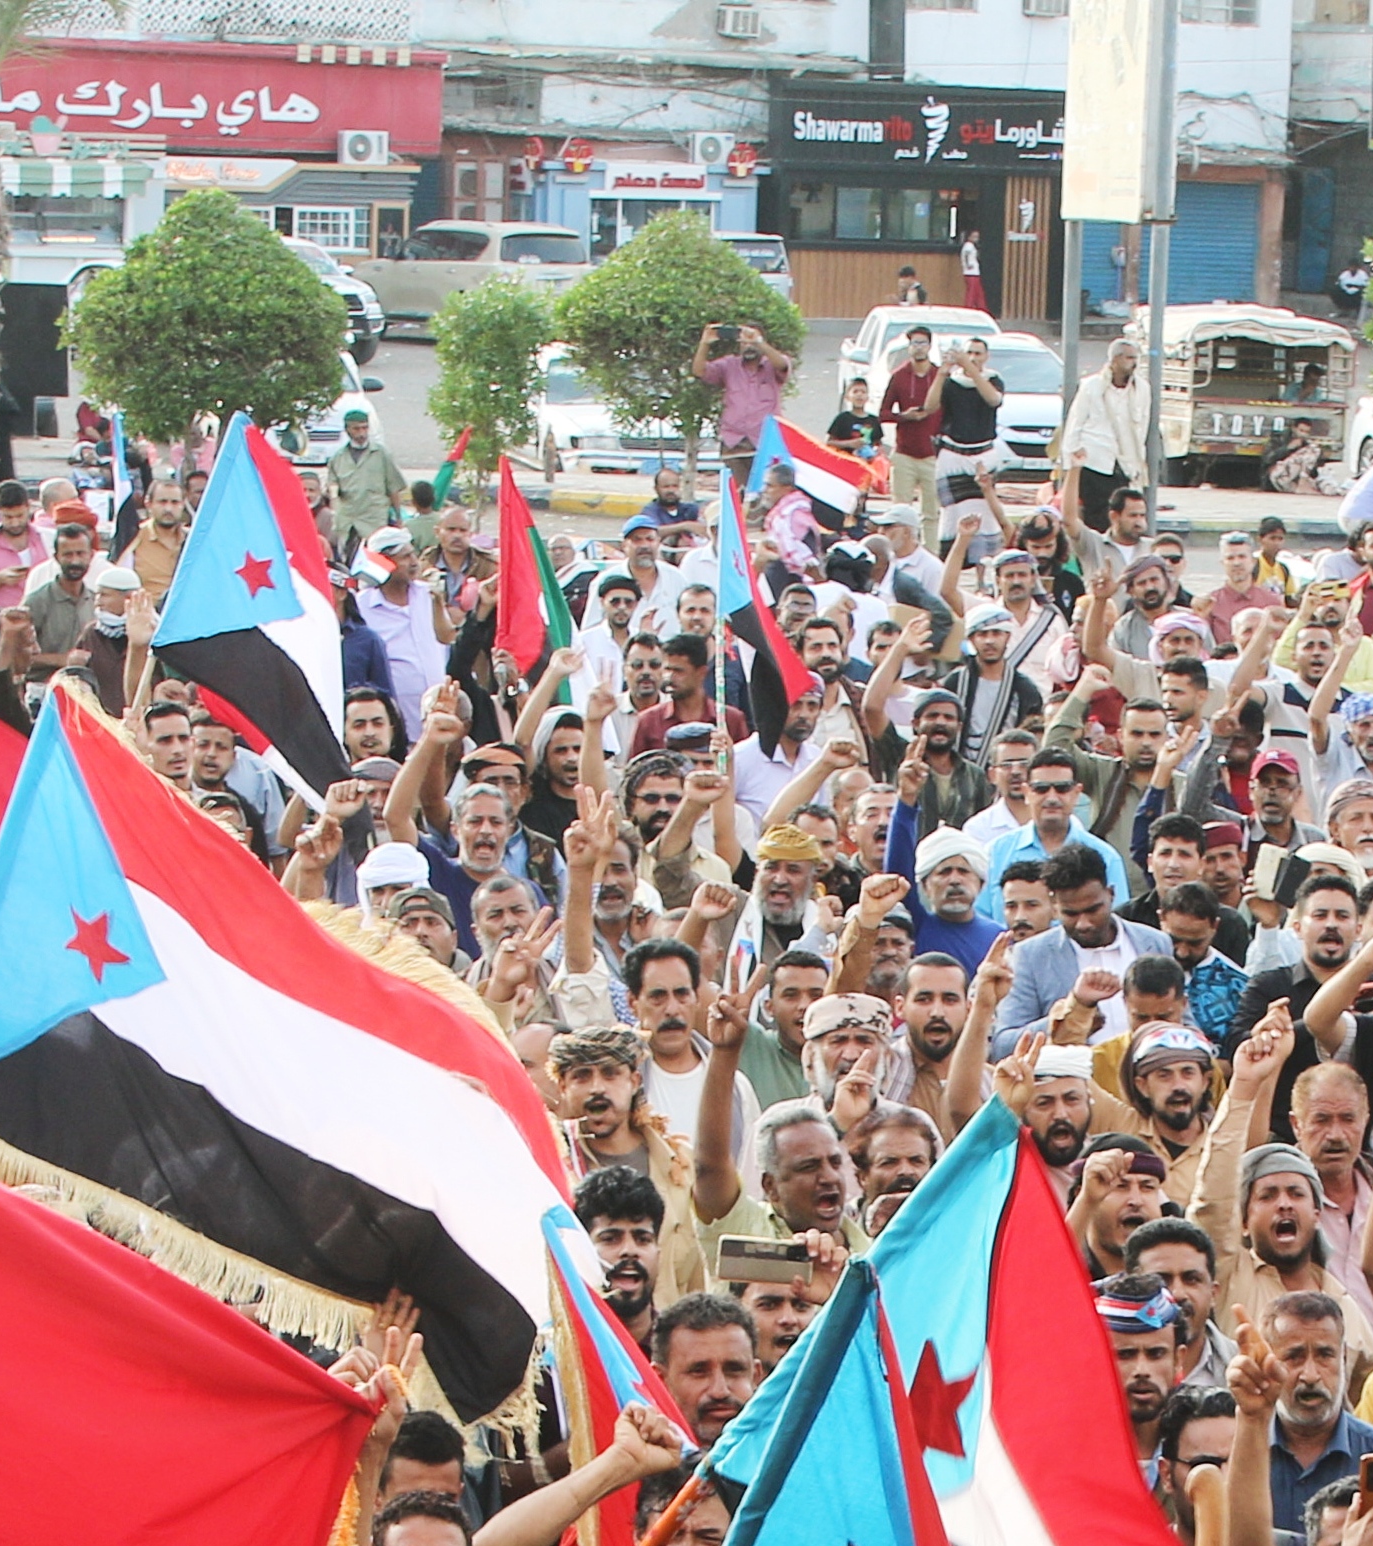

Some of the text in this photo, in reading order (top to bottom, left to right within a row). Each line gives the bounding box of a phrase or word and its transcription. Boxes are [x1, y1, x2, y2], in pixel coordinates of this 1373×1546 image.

[54, 79, 209, 129] بارك
[216, 86, 320, 136] هاي
[793, 110, 913, 143] Shawarmarito
